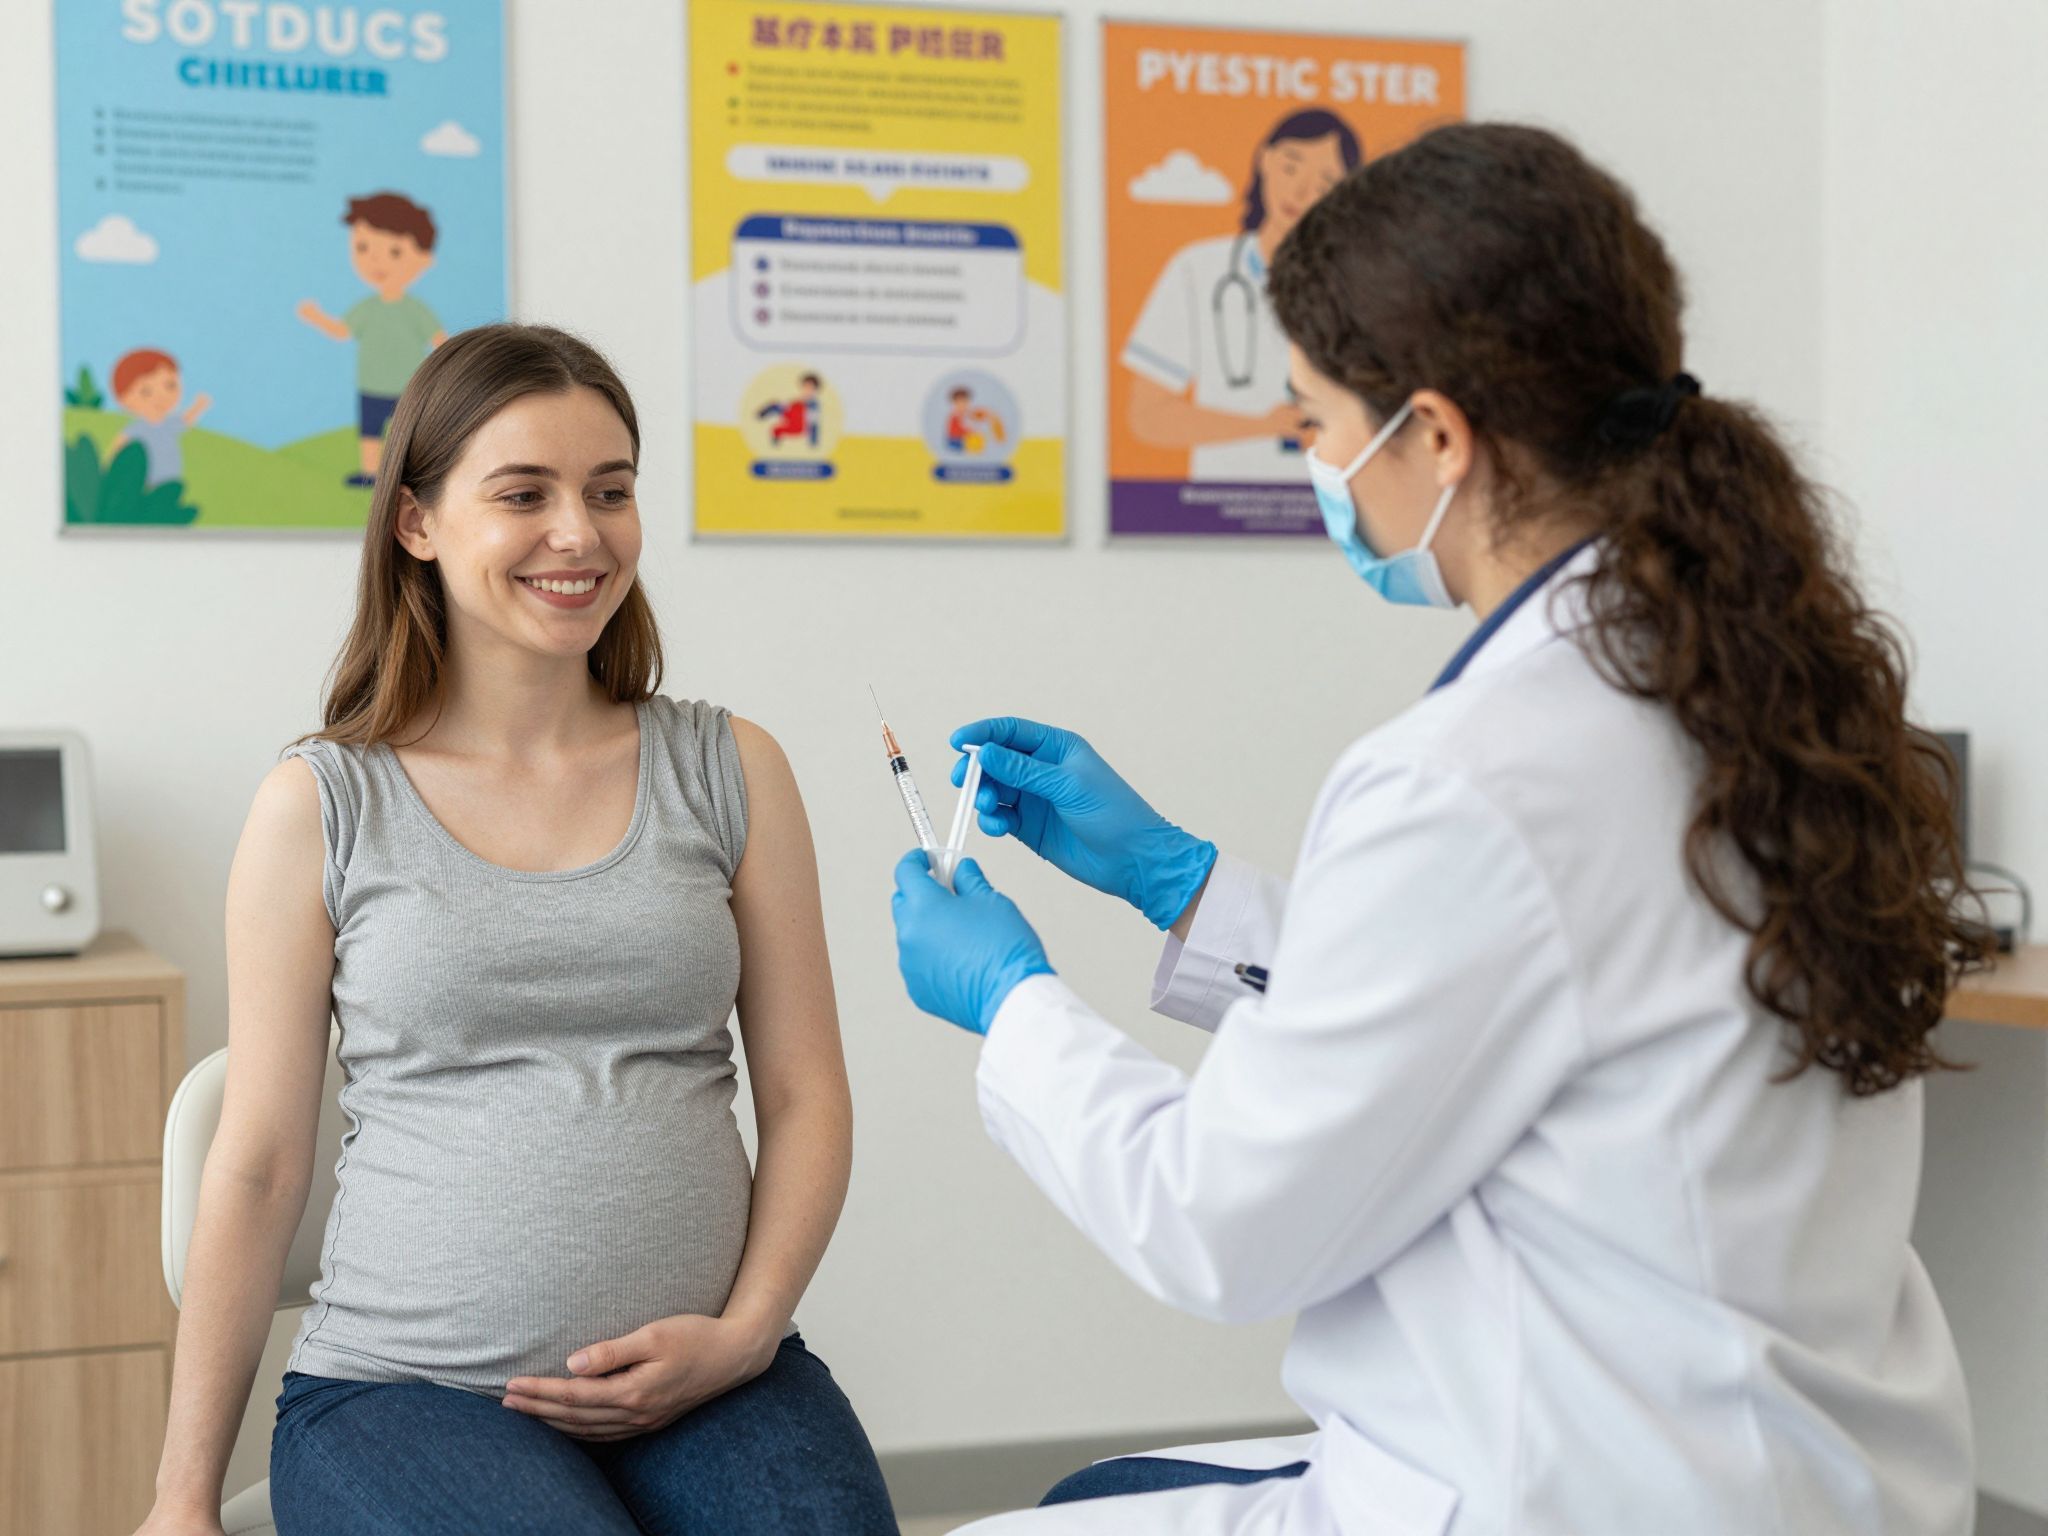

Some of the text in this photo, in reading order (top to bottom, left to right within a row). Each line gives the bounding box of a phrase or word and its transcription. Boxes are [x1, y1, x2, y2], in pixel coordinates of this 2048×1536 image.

[121, 0, 448, 62] SOTDUCS
[1137, 48, 1440, 106] PYESTIC STER
